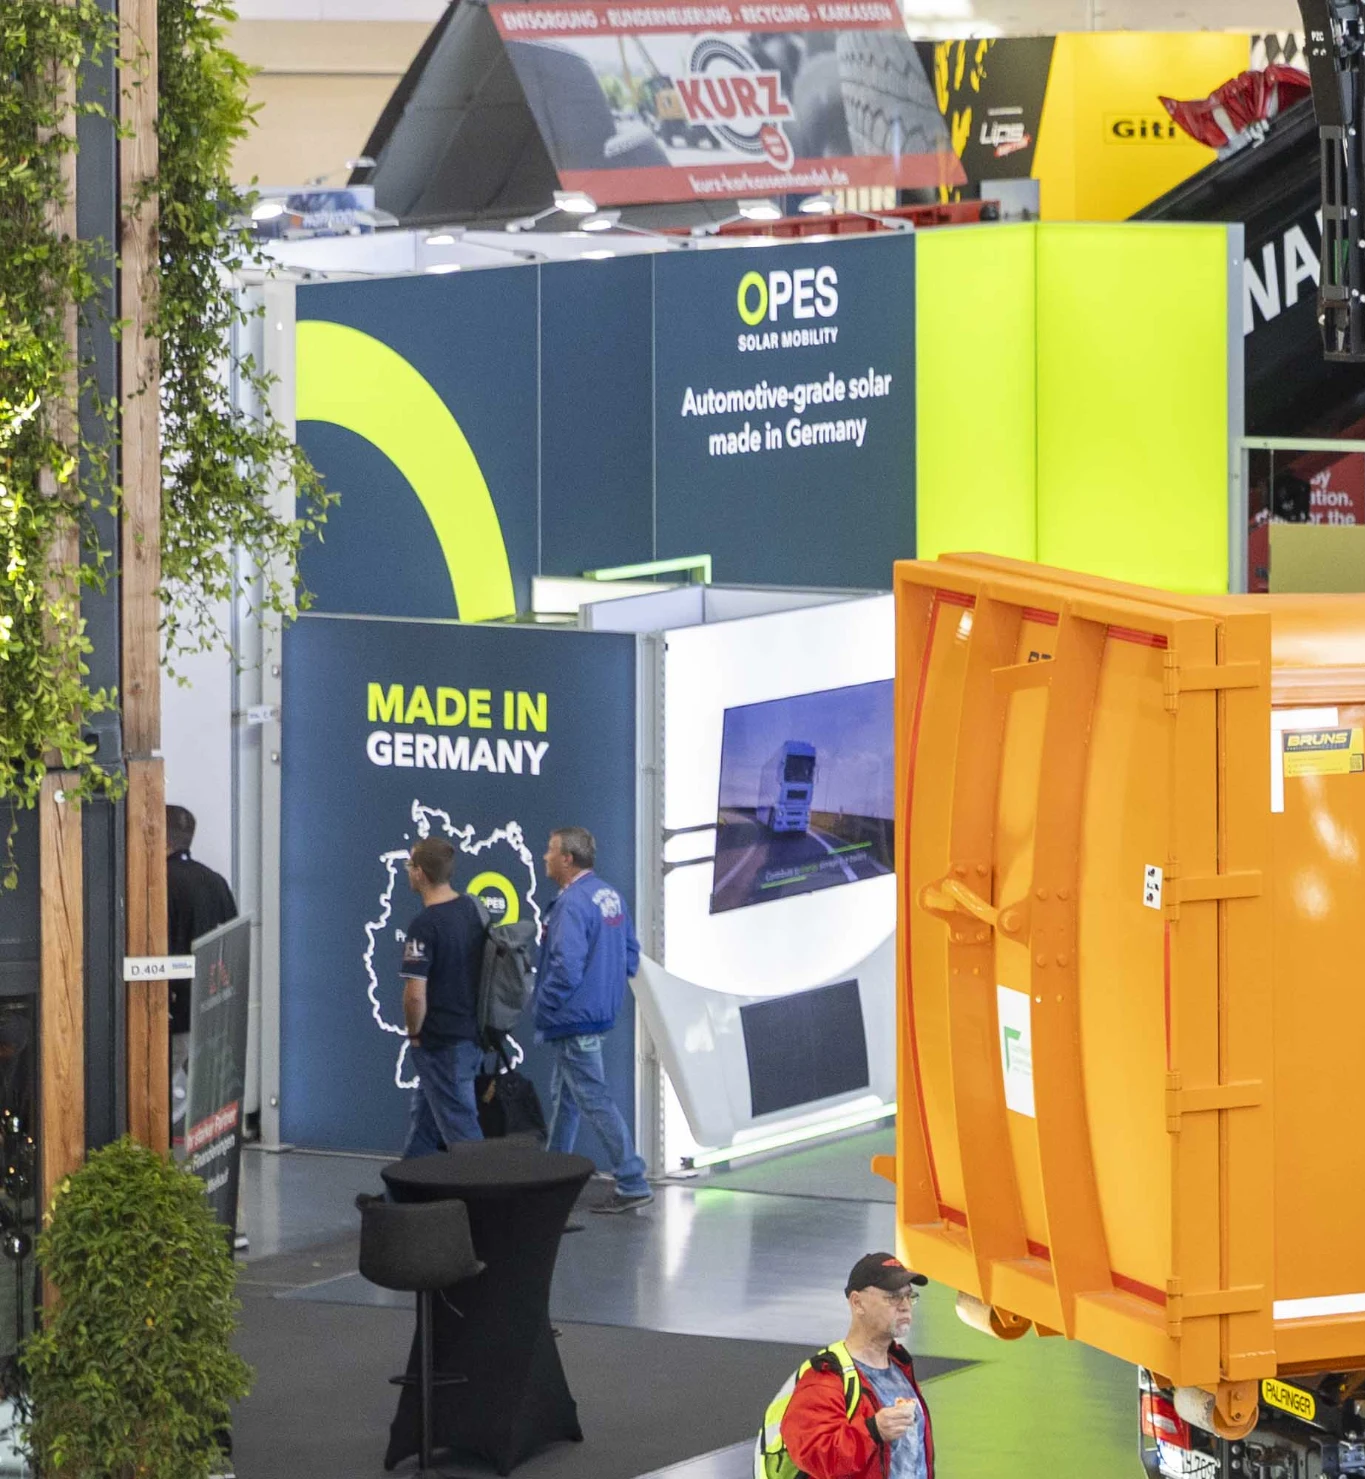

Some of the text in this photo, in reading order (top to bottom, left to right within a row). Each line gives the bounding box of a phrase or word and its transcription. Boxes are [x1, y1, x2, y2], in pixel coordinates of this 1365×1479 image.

[502, 10, 598, 30] ENTSORGUNG
[742, 4, 811, 25] RECYCLING
[820, 2, 893, 23] KARKASSEN
[676, 75, 791, 119] KURZ
[1111, 119, 1177, 139] Giti
[690, 167, 849, 195] kurz-karkassenhandel.de
[737, 265, 839, 326] OPES
[737, 326, 839, 352] SOLAR MOBILITY
[681, 366, 893, 417] Automotive-grade solar
[708, 417, 868, 456] made in Germany
[367, 682, 548, 733] MADE IN
[366, 730, 549, 776] GERMANY
[1287, 732, 1348, 748] BRUNS
[131, 964, 166, 977] D.404
[1265, 1382, 1311, 1416] PALFINGER
